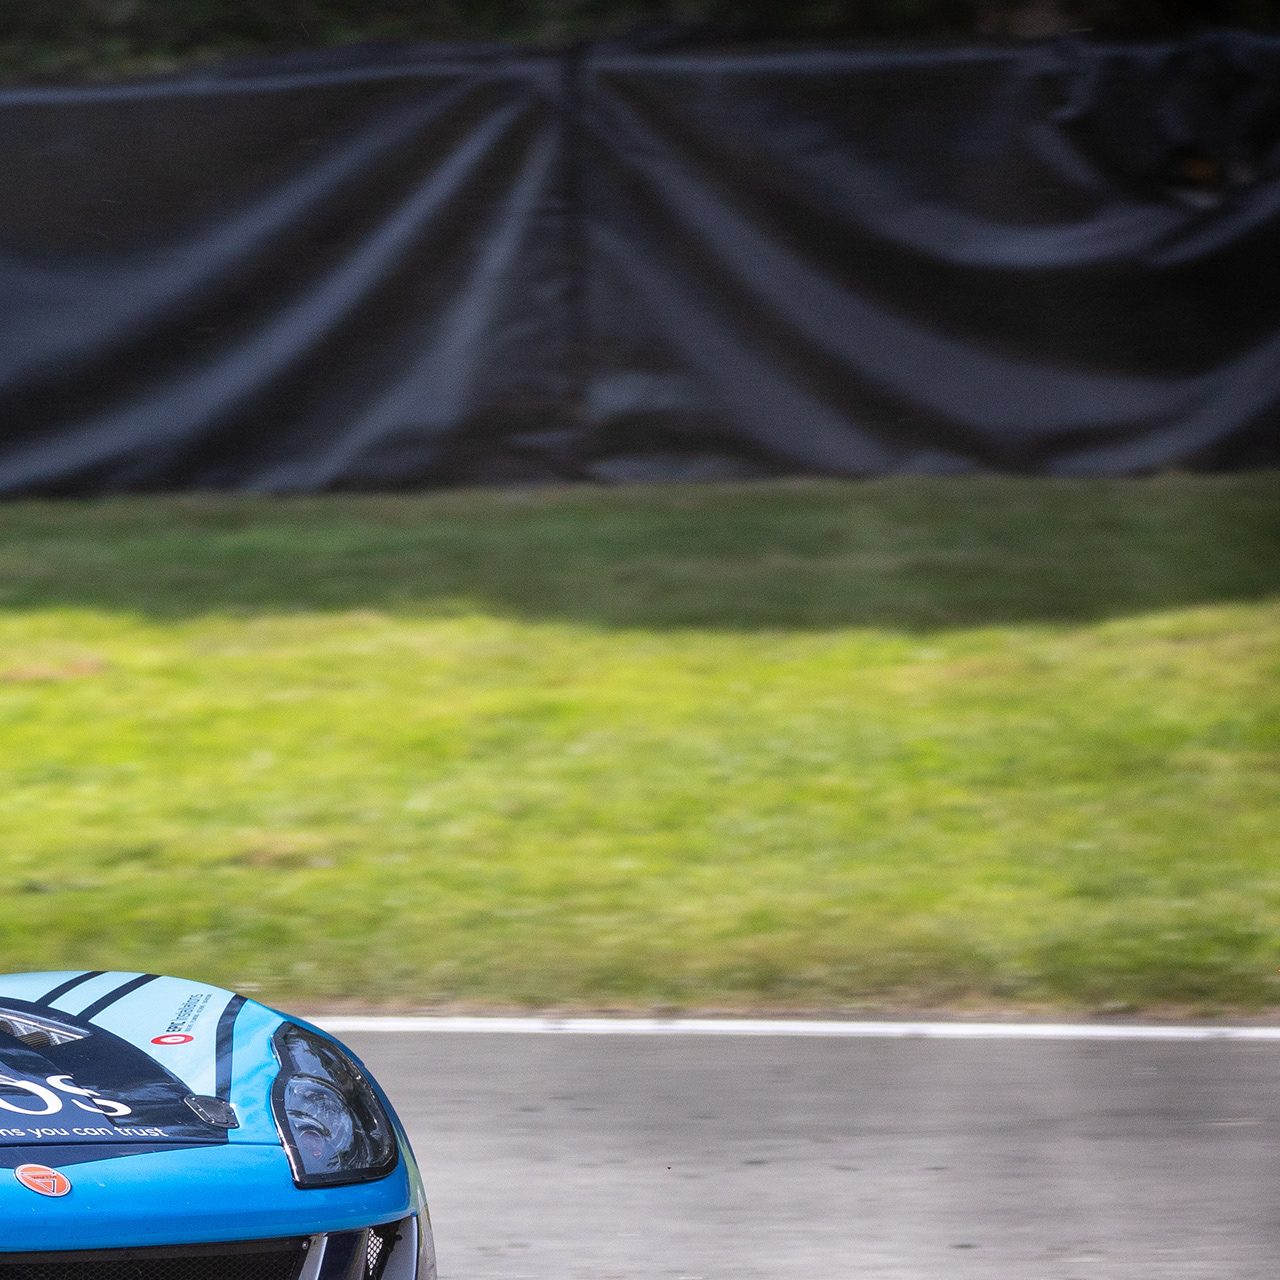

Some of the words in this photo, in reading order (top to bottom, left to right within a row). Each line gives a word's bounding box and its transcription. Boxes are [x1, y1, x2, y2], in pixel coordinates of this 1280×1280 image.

[27, 1126, 68, 1138] you
[72, 1126, 113, 1136] can
[113, 1125, 169, 1138] trust
